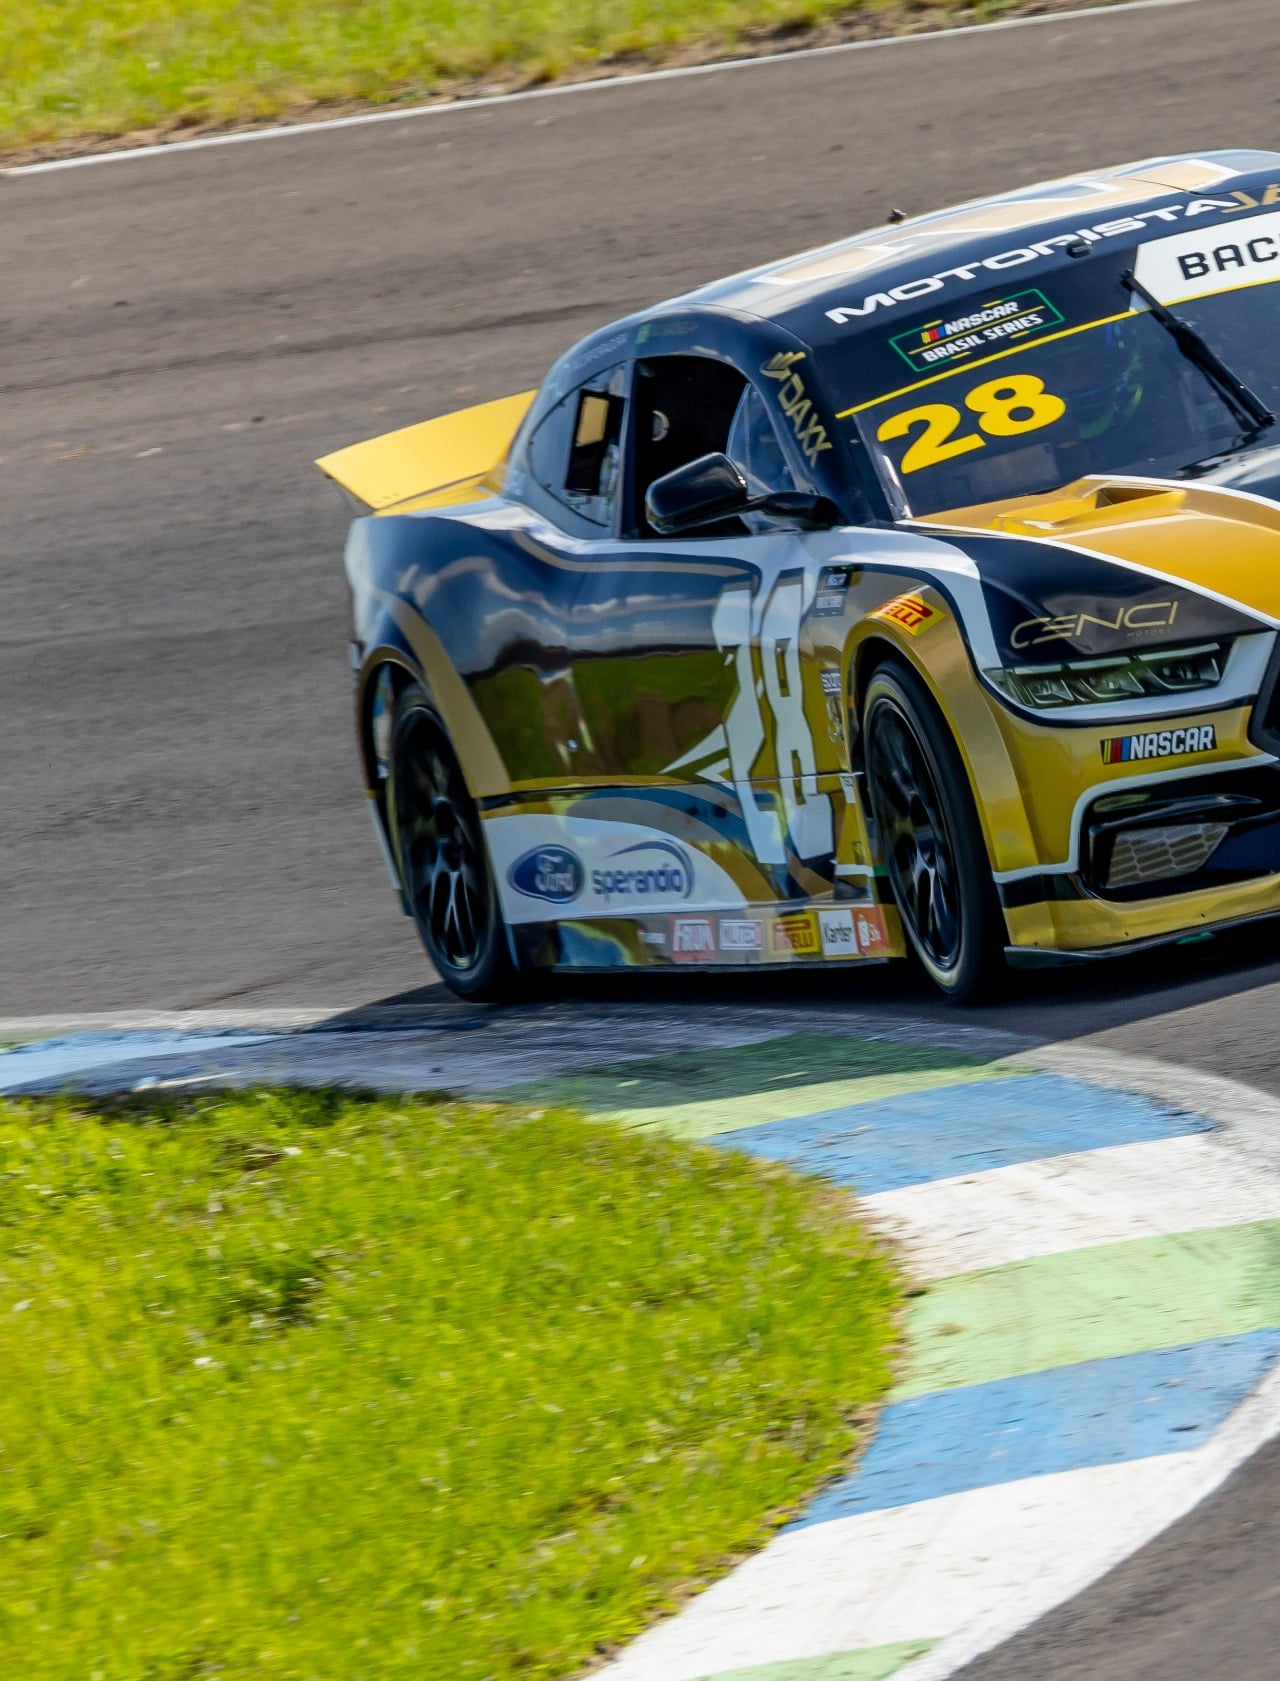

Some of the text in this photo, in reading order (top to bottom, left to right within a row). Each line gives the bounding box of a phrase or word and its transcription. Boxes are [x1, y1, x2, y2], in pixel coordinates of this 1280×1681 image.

[921, 313, 1044, 363] BRASIL SERIES
[944, 301, 1019, 336] NASCAR
[876, 373, 1067, 475] 28
[1010, 600, 1179, 649] CENCI
[1130, 725, 1214, 760] NASCAR
[534, 854, 577, 893] Ford
[591, 862, 684, 903] sperandio
